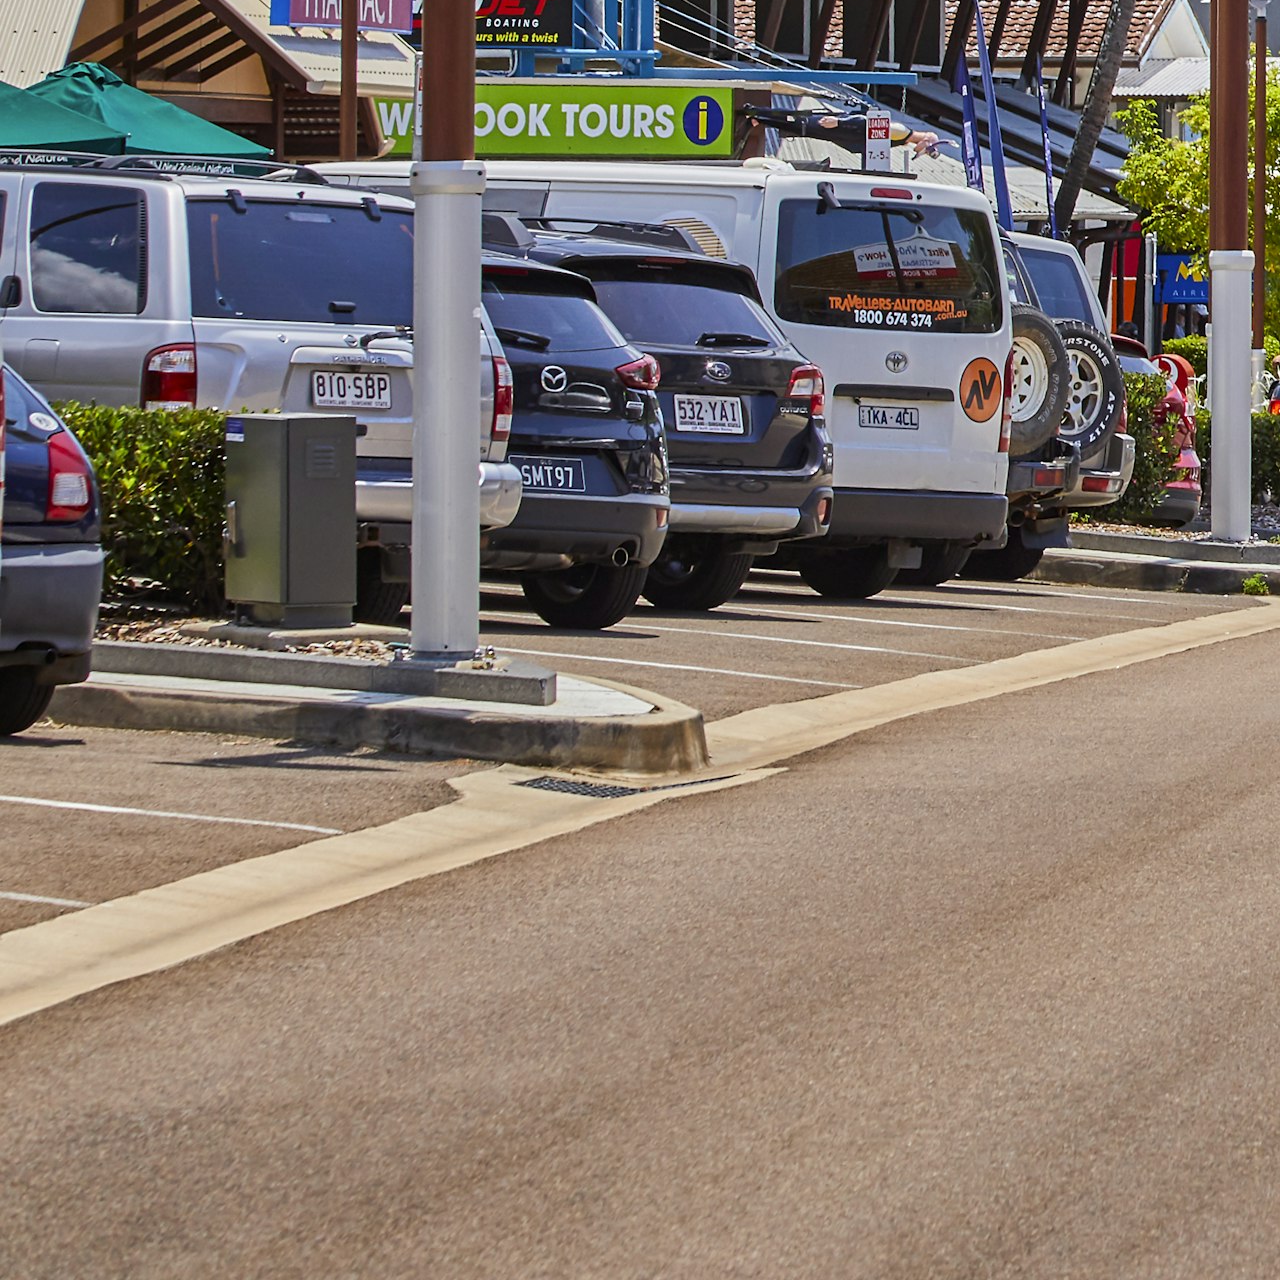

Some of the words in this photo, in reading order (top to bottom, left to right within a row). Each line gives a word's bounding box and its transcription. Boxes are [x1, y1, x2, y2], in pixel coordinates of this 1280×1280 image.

[486, 18, 540, 28] BOATING
[475, 34, 493, 43] urs
[496, 33, 519, 42] with
[531, 32, 558, 43] twist
[378, 103, 413, 136] W
[475, 103, 551, 137] OOK
[561, 103, 674, 138] TOURS
[871, 129, 886, 139] ZONE
[1172, 289, 1206, 297] AIRL
[853, 309, 883, 325] 1800
[885, 311, 907, 326] 674
[910, 312, 932, 328] 374
[935, 310, 968, 321] .com.au
[1063, 337, 1110, 367] RSTONE
[521, 465, 573, 488] SMT97
